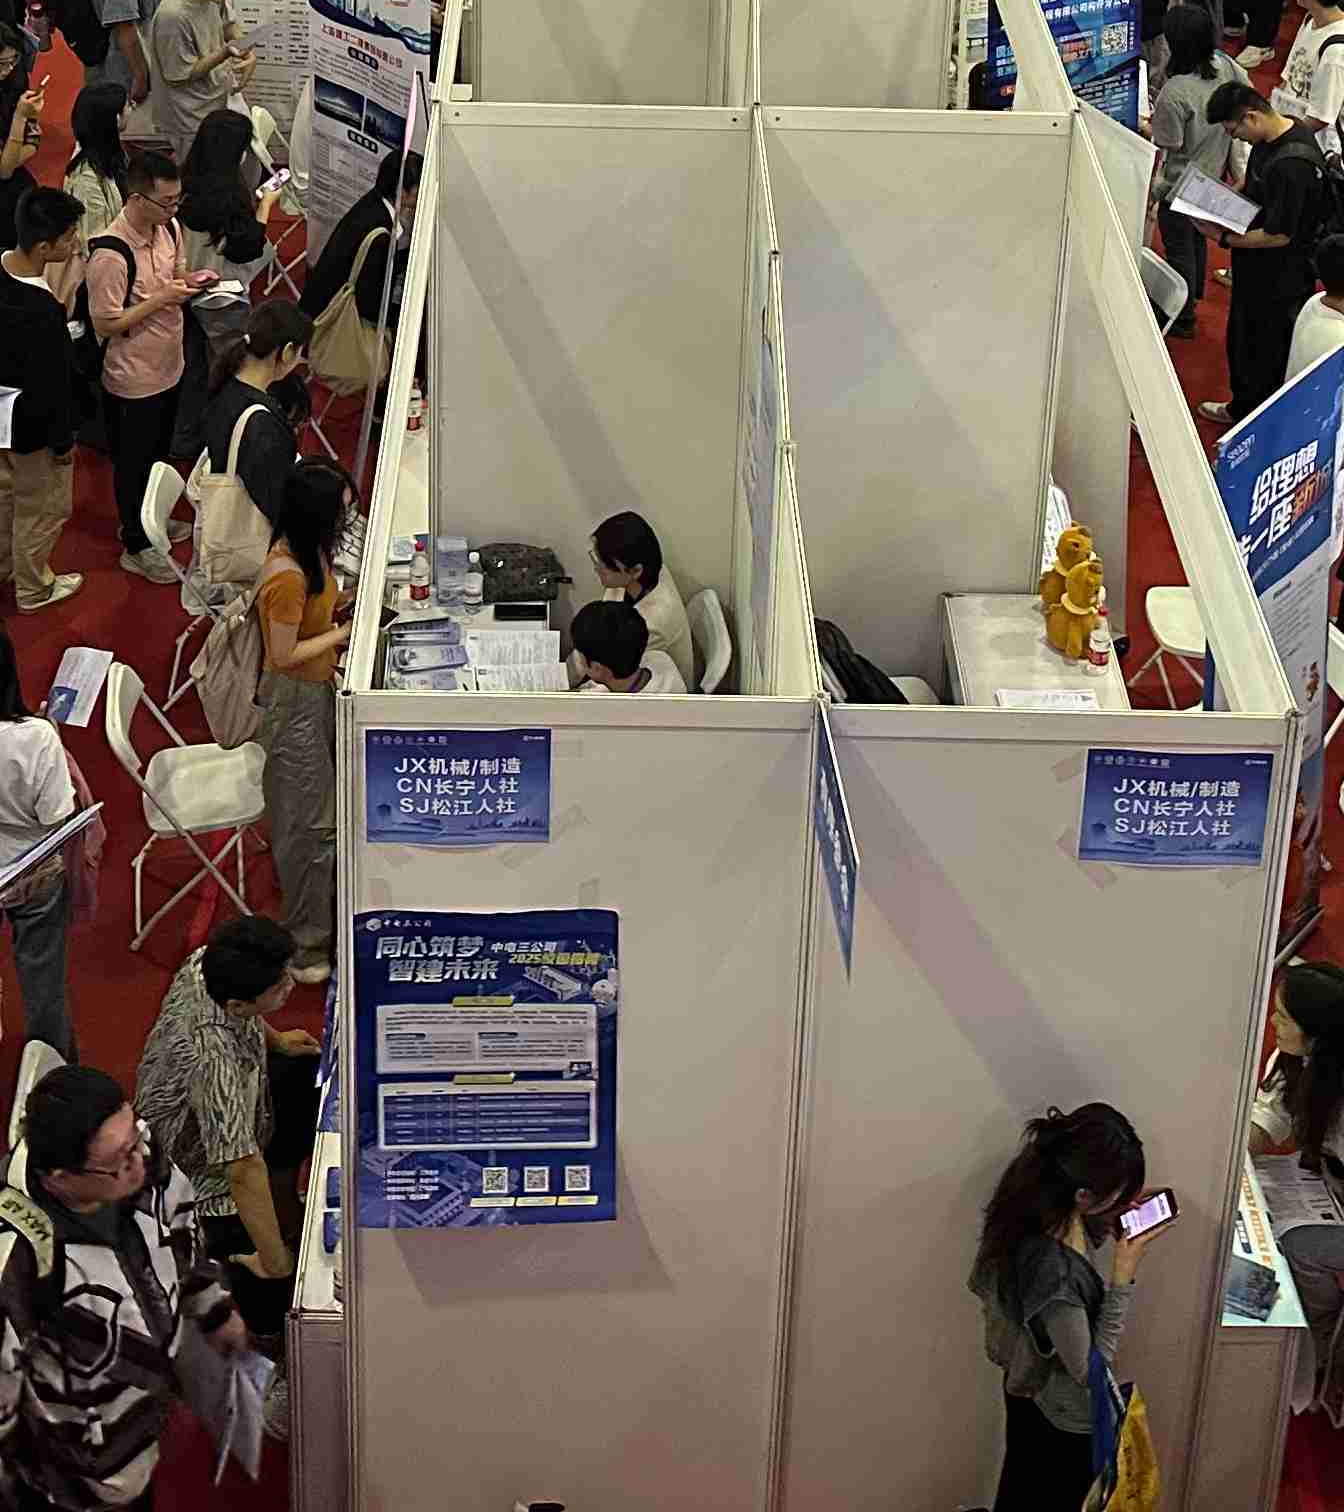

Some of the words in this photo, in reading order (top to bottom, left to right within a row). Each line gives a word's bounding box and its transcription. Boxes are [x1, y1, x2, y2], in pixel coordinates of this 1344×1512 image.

[394, 757, 521, 776] JX机械/制造
[396, 777, 519, 796] CN长宁人社
[1113, 778, 1240, 798] JX机械/制造
[399, 796, 517, 816] SJ松江人社
[1114, 798, 1236, 817] CN长宁人社
[1115, 818, 1232, 836] SJ松江人社
[376, 935, 484, 960] 同心筑梦
[389, 958, 499, 983] 智建未来
